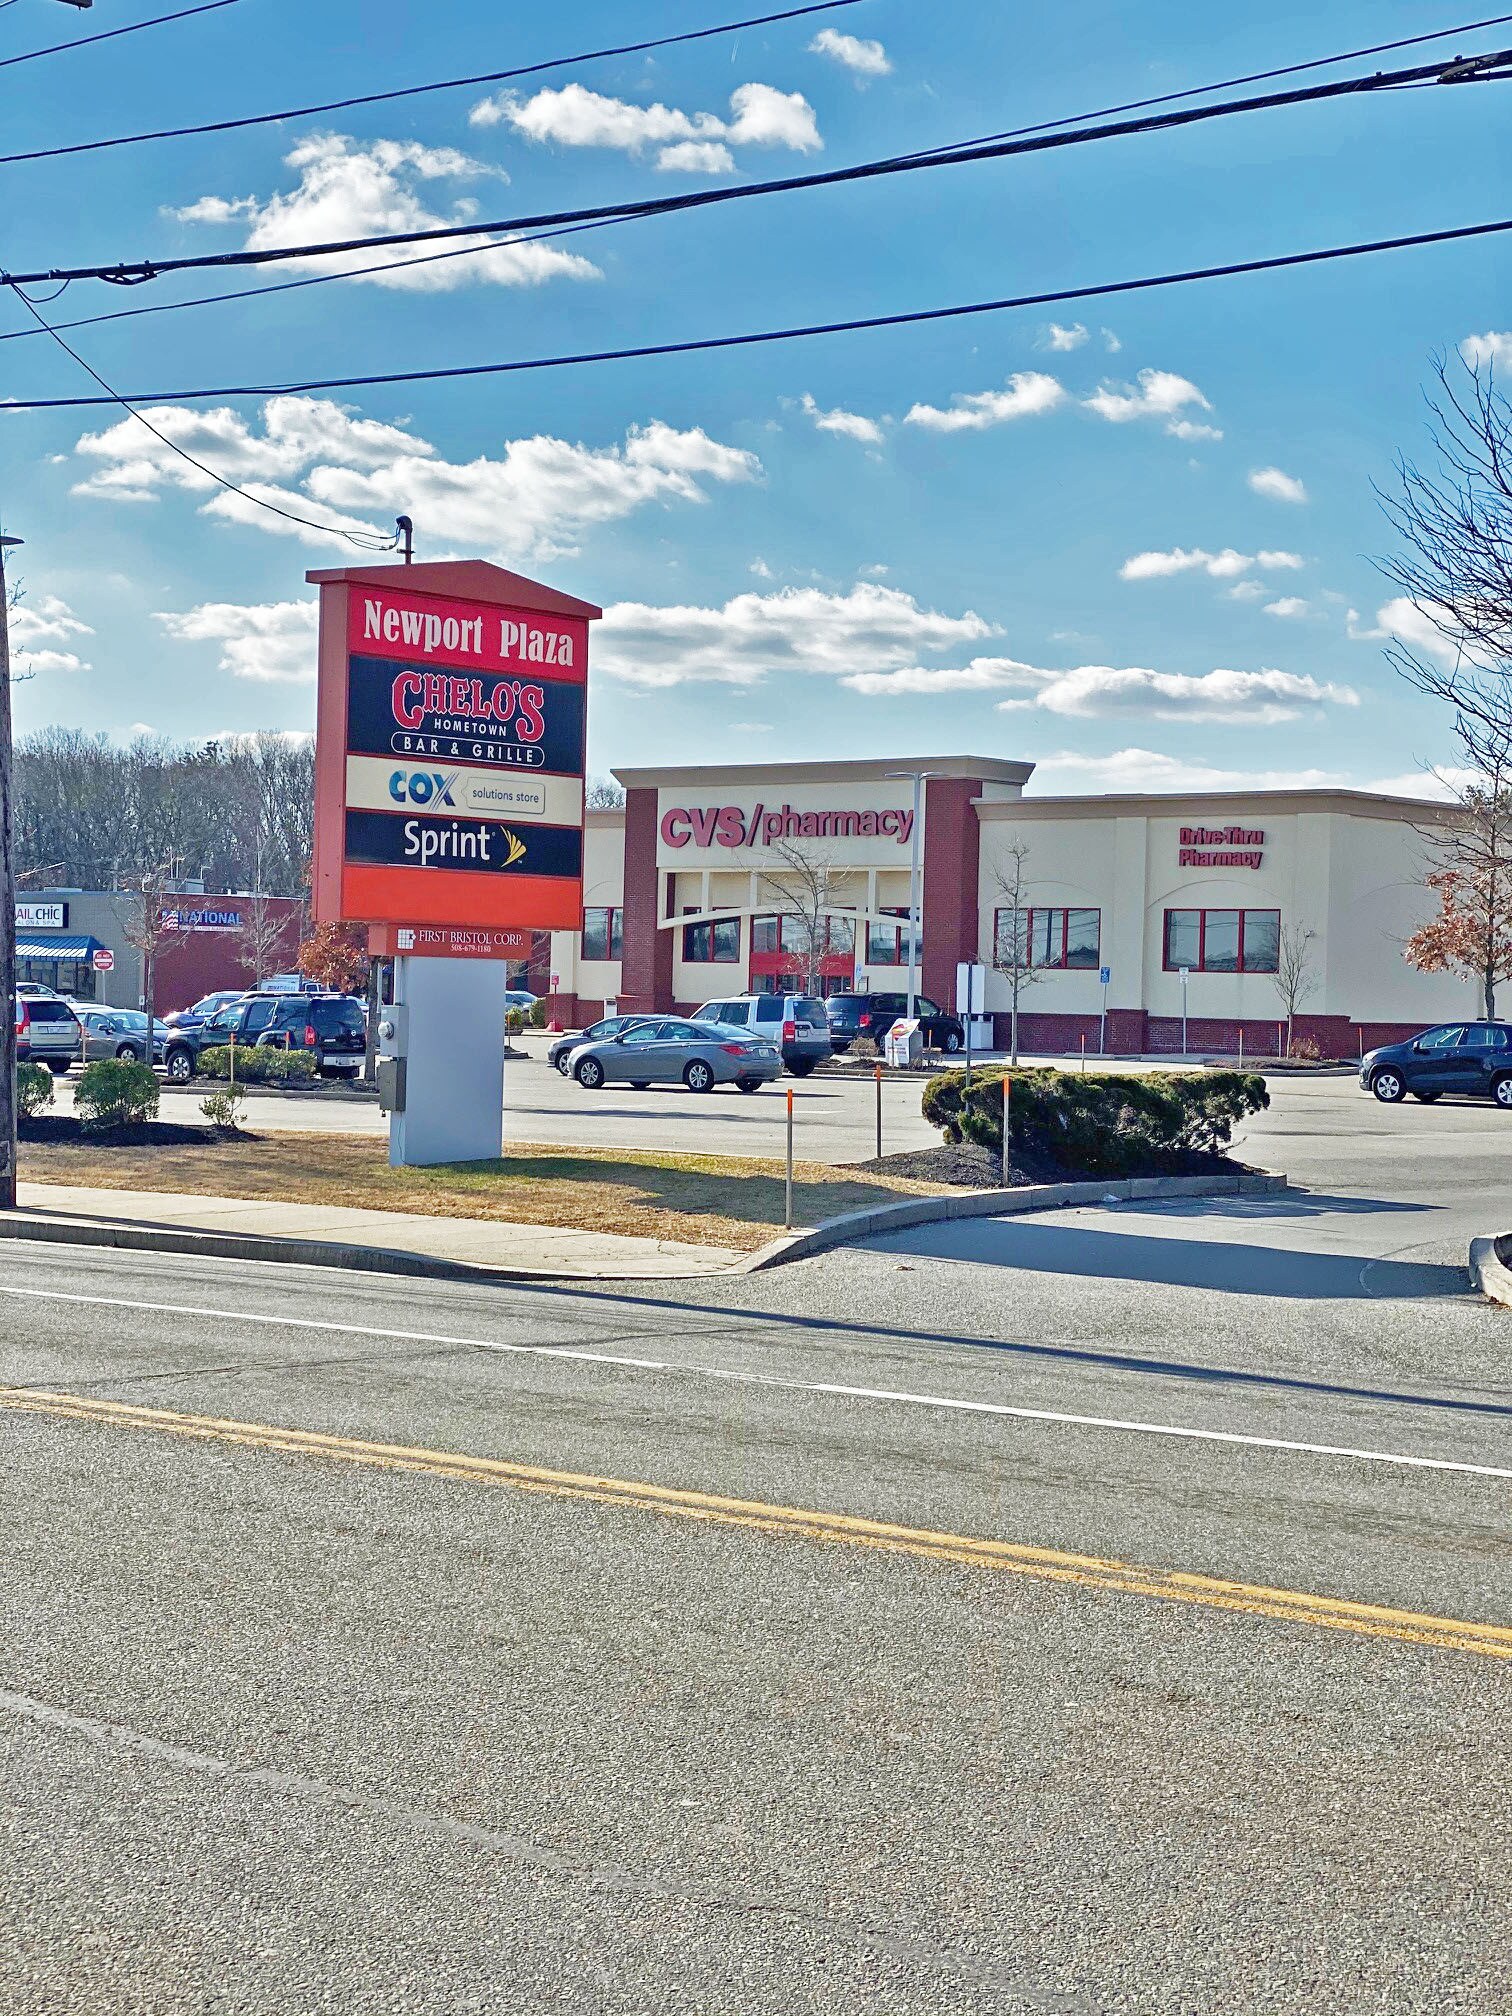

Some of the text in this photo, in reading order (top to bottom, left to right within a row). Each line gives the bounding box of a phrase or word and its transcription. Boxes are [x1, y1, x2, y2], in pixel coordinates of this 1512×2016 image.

[364, 599, 574, 667] Newport Plaza
[391, 671, 545, 742] CHELO'S
[434, 718, 507, 737] HOMETOWN
[403, 736, 533, 763] BAR & GRILLE
[472, 786, 513, 802] solutions
[516, 791, 540, 804] store
[404, 820, 490, 866] Sprint
[1180, 826, 1264, 845] Drive-Thru
[1179, 849, 1263, 870] Pharmacy
[15, 908, 34, 920] AIL
[418, 930, 524, 946] FIRST BRISTOL CORP.
